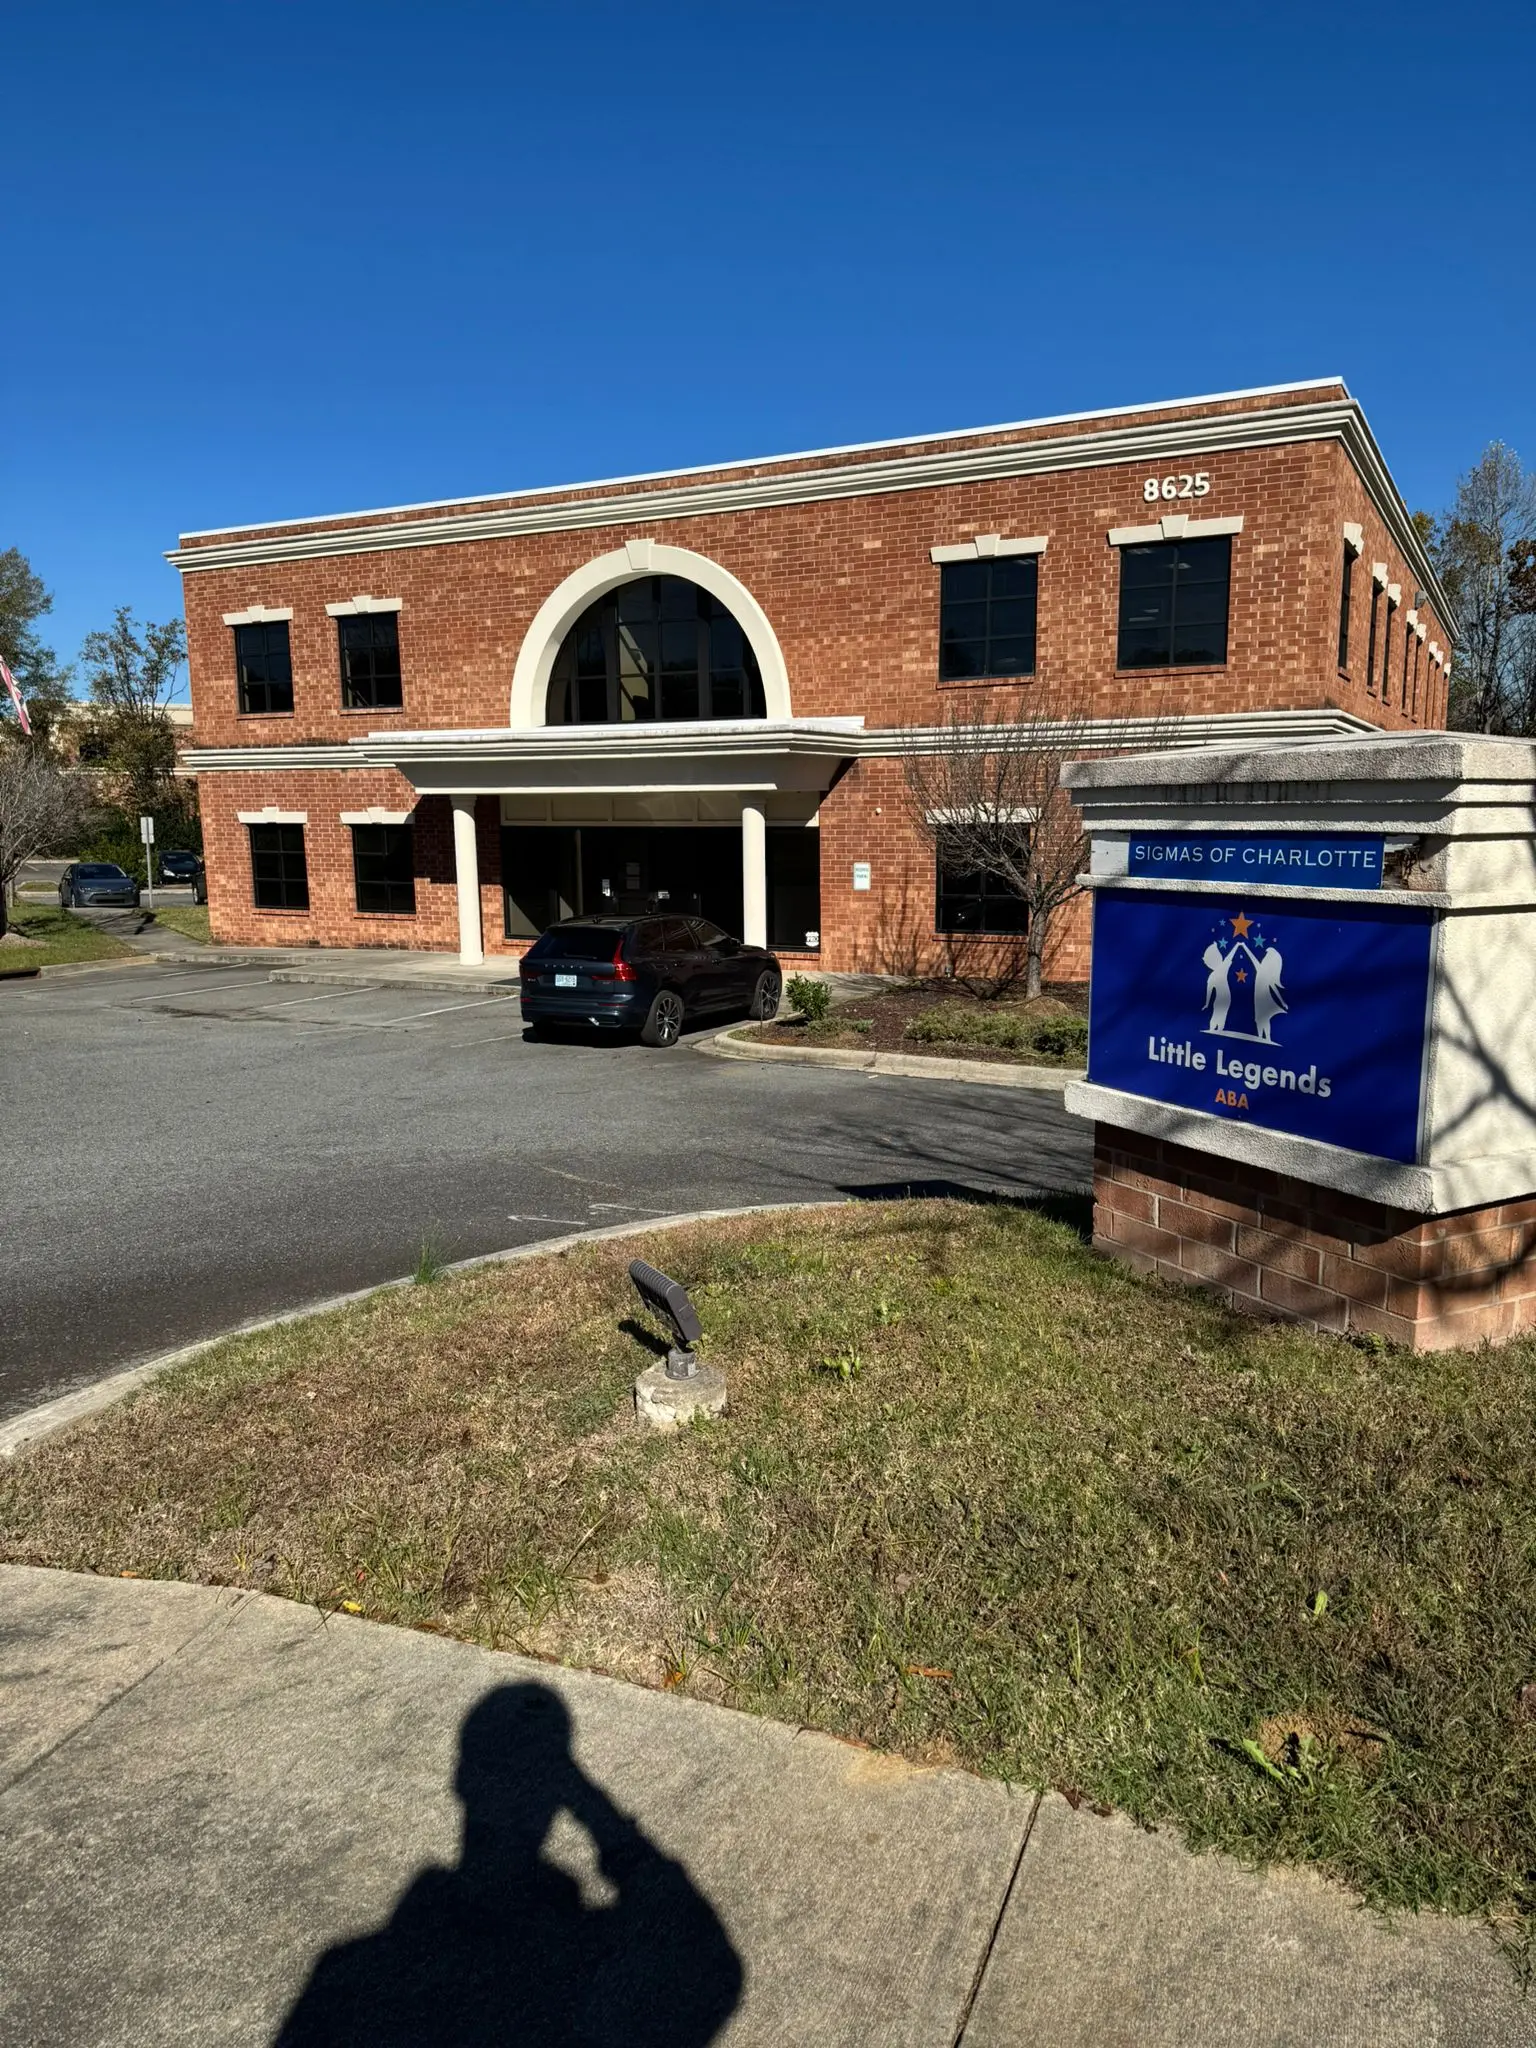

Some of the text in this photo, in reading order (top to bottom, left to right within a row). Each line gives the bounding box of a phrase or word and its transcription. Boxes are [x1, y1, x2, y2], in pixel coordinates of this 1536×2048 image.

[1142, 472, 1210, 502] 8625
[1135, 846, 1376, 868] SIGMAS OF CHARLOTTE
[1148, 1036, 1331, 1097] Little Legends
[1215, 1088, 1249, 1110] ABA
